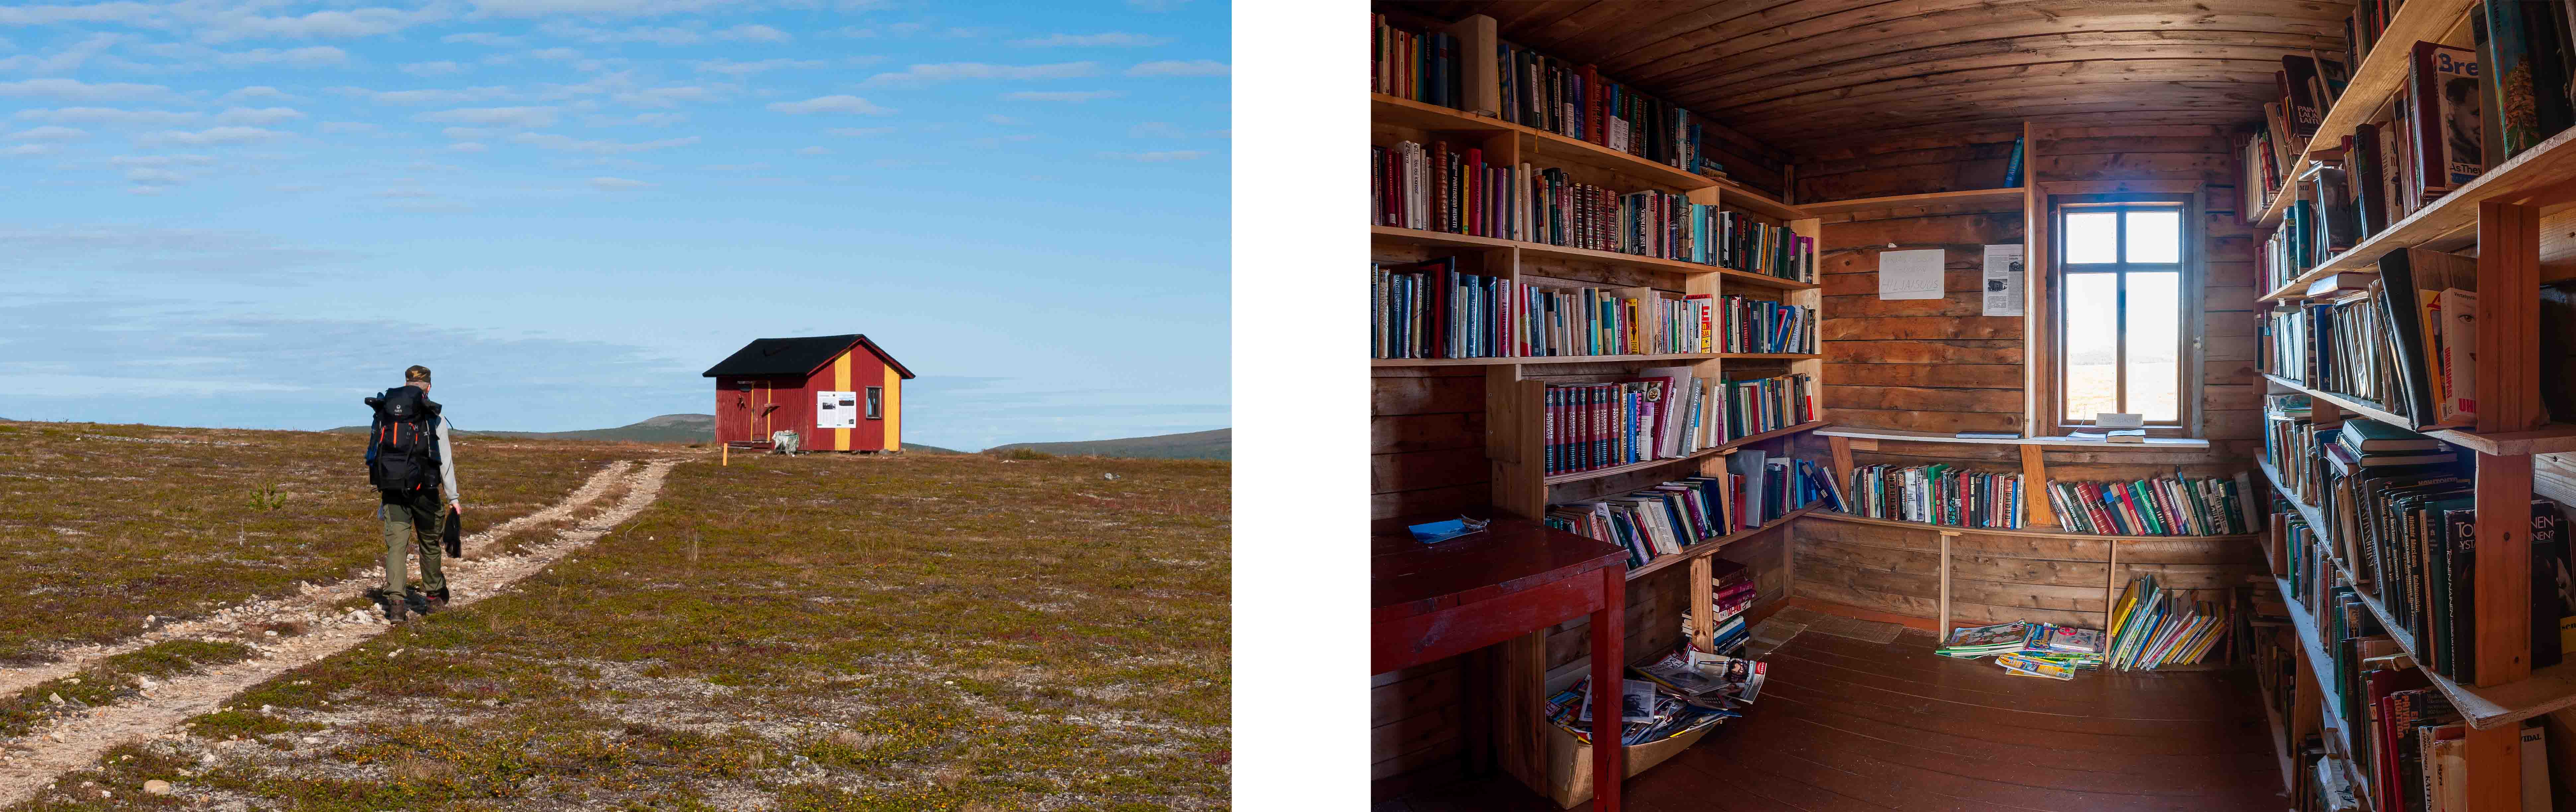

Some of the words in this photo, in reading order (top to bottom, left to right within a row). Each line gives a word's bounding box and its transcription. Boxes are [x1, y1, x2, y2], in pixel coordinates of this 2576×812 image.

[1546, 395, 1553, 403] 2
[1559, 394, 1564, 403] 3
[1569, 394, 1575, 402] 4
[1594, 393, 1599, 401] 6
[2066, 501, 2076, 517] PIHLAJAPUU
[1726, 603, 1741, 616] TAI-PAN
